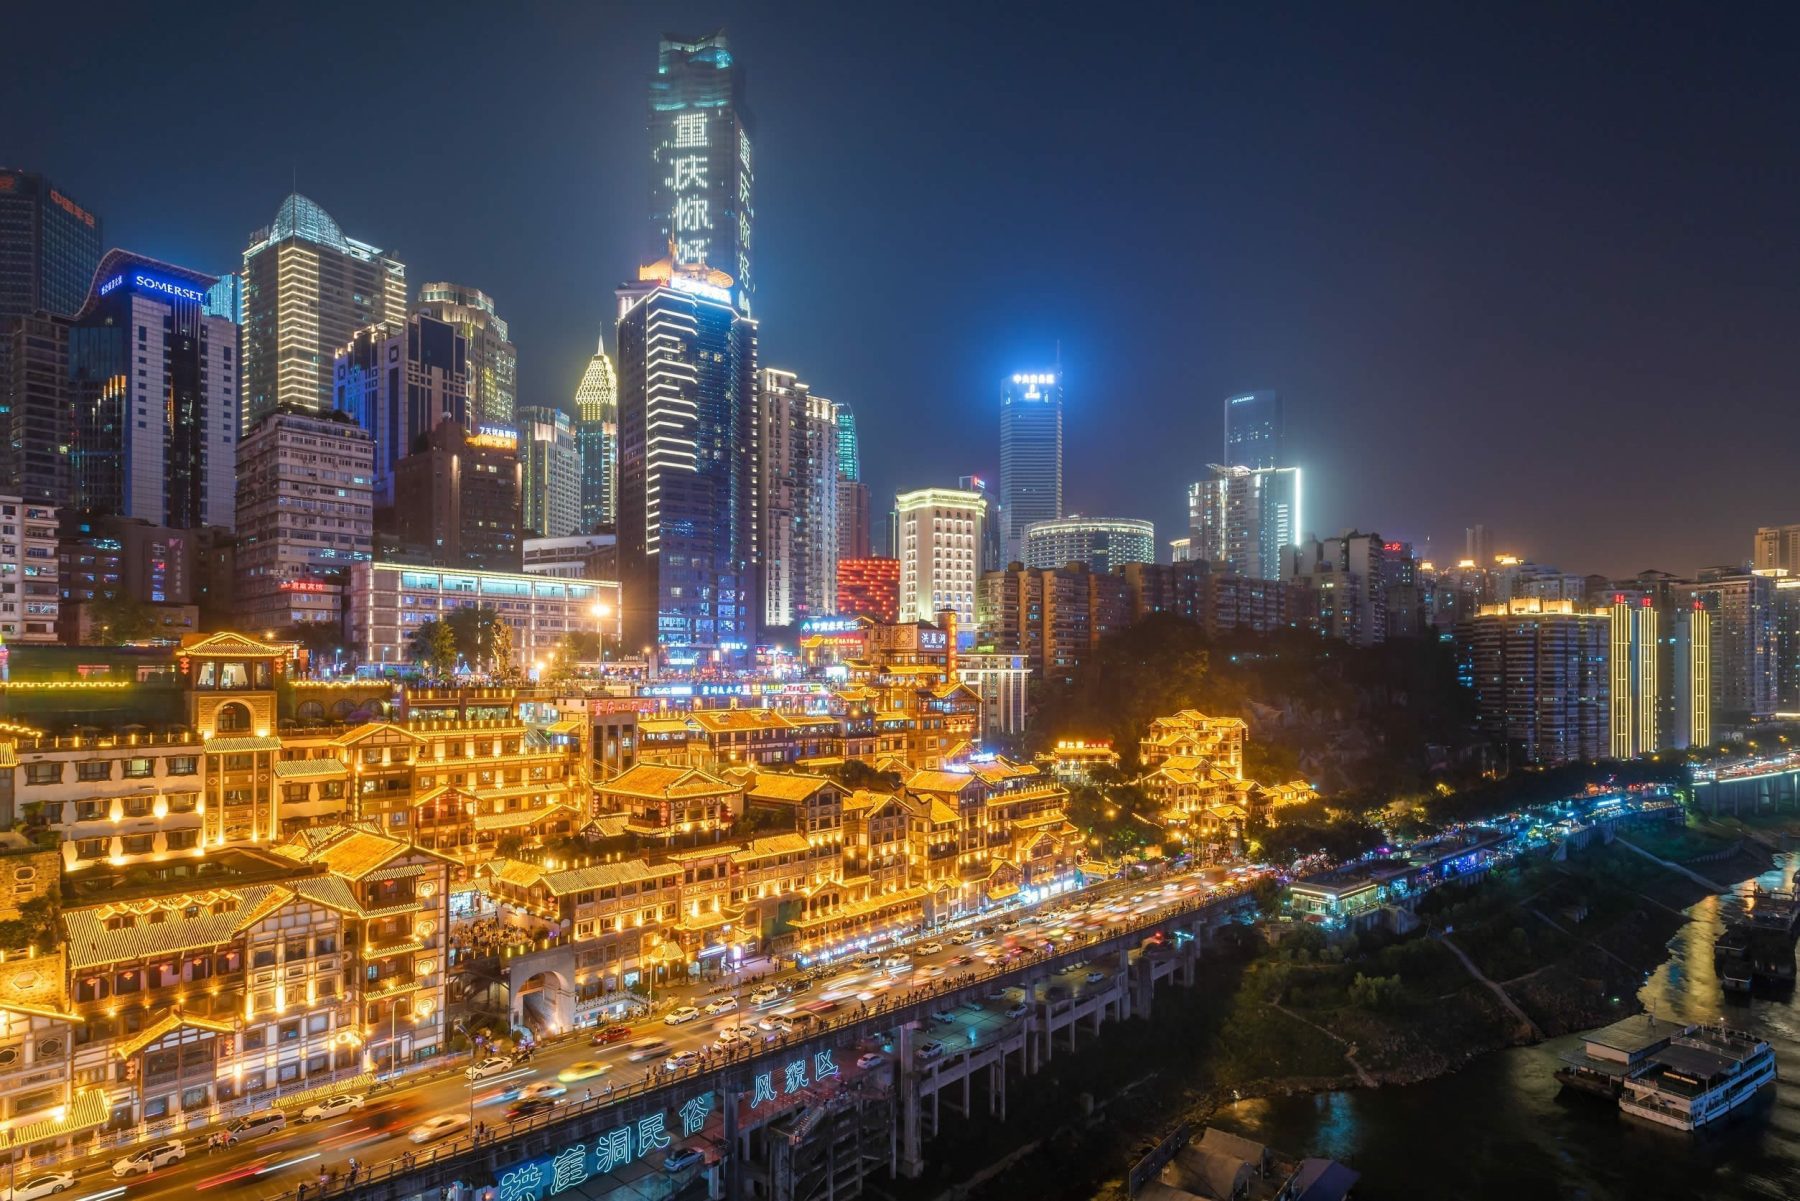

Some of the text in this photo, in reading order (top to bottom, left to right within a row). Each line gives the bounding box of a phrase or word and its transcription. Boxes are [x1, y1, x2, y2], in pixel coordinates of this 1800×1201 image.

[136, 275, 204, 302] SOMERSET
[921, 632, 946, 645] 洪崖洞
